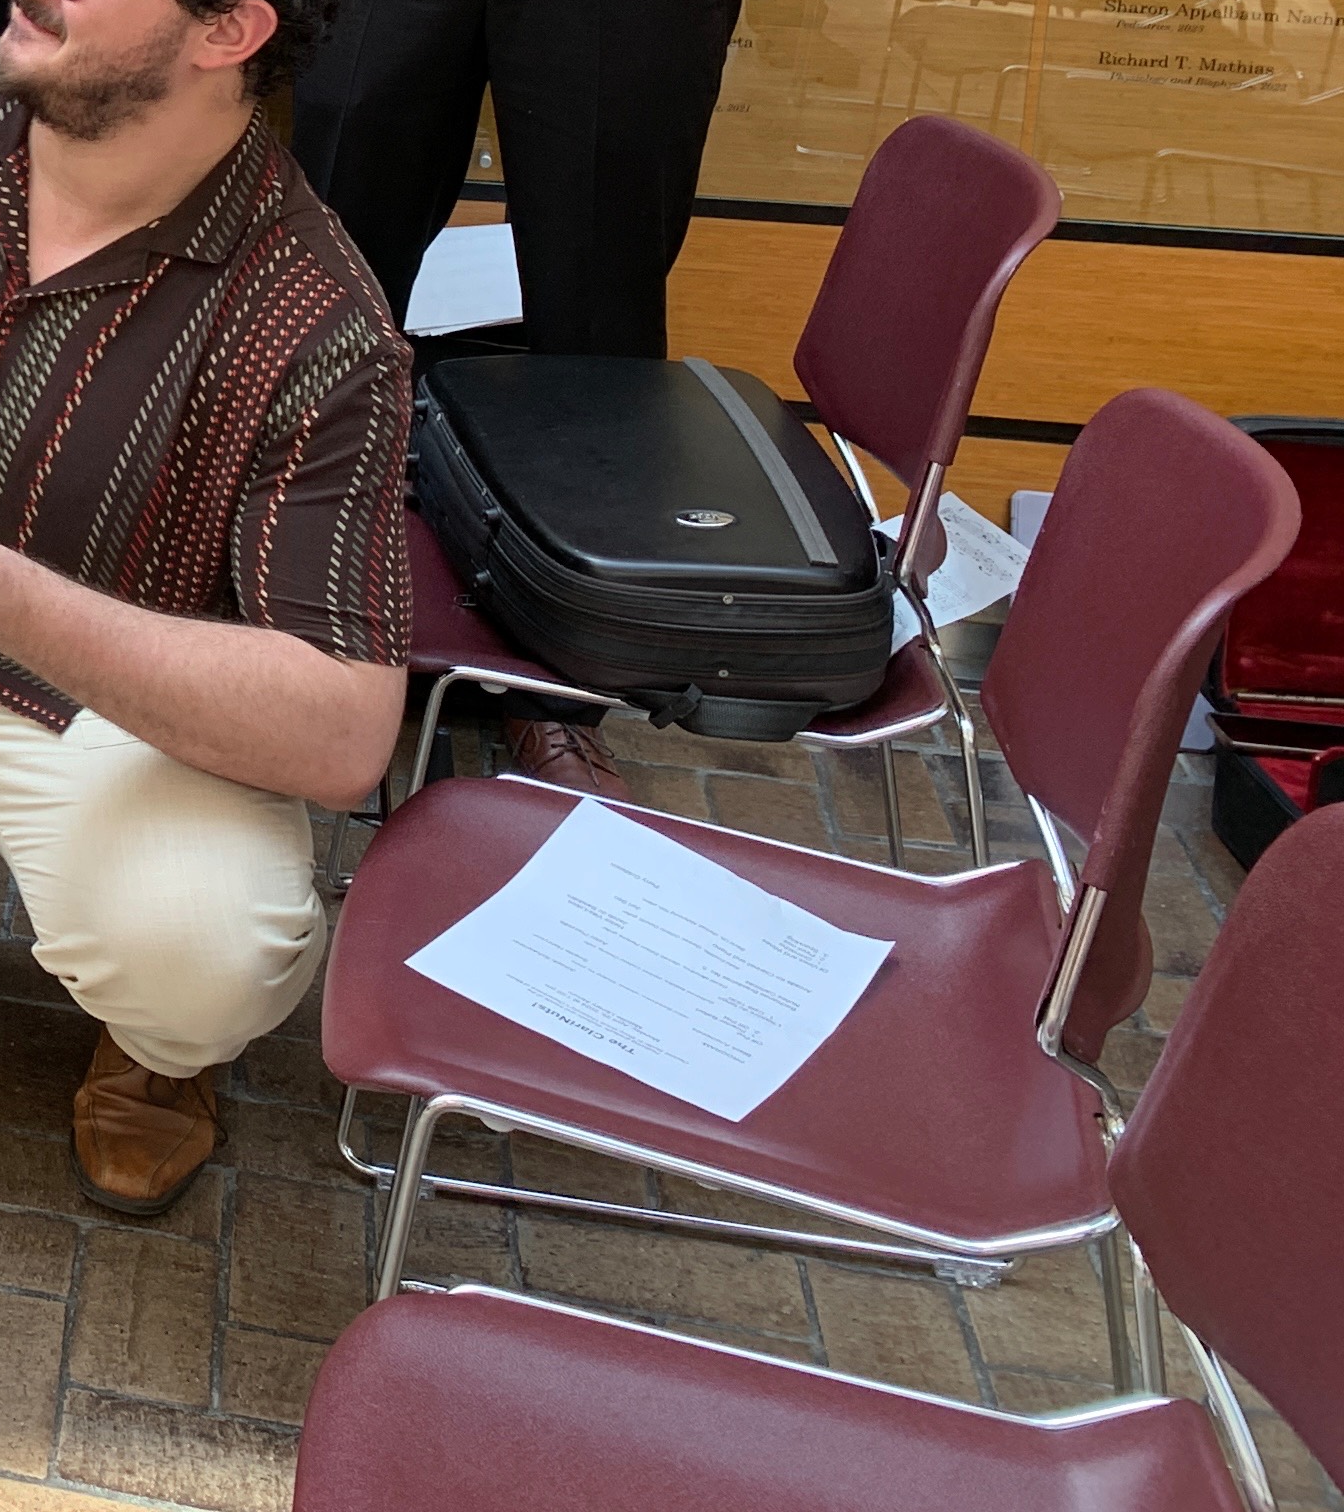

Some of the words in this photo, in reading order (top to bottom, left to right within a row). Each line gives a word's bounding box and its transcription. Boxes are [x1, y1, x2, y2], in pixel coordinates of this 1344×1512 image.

[1098, 51, 1168, 68] Richard
[1199, 57, 1274, 75] Mathias
[609, 1039, 635, 1055] The
